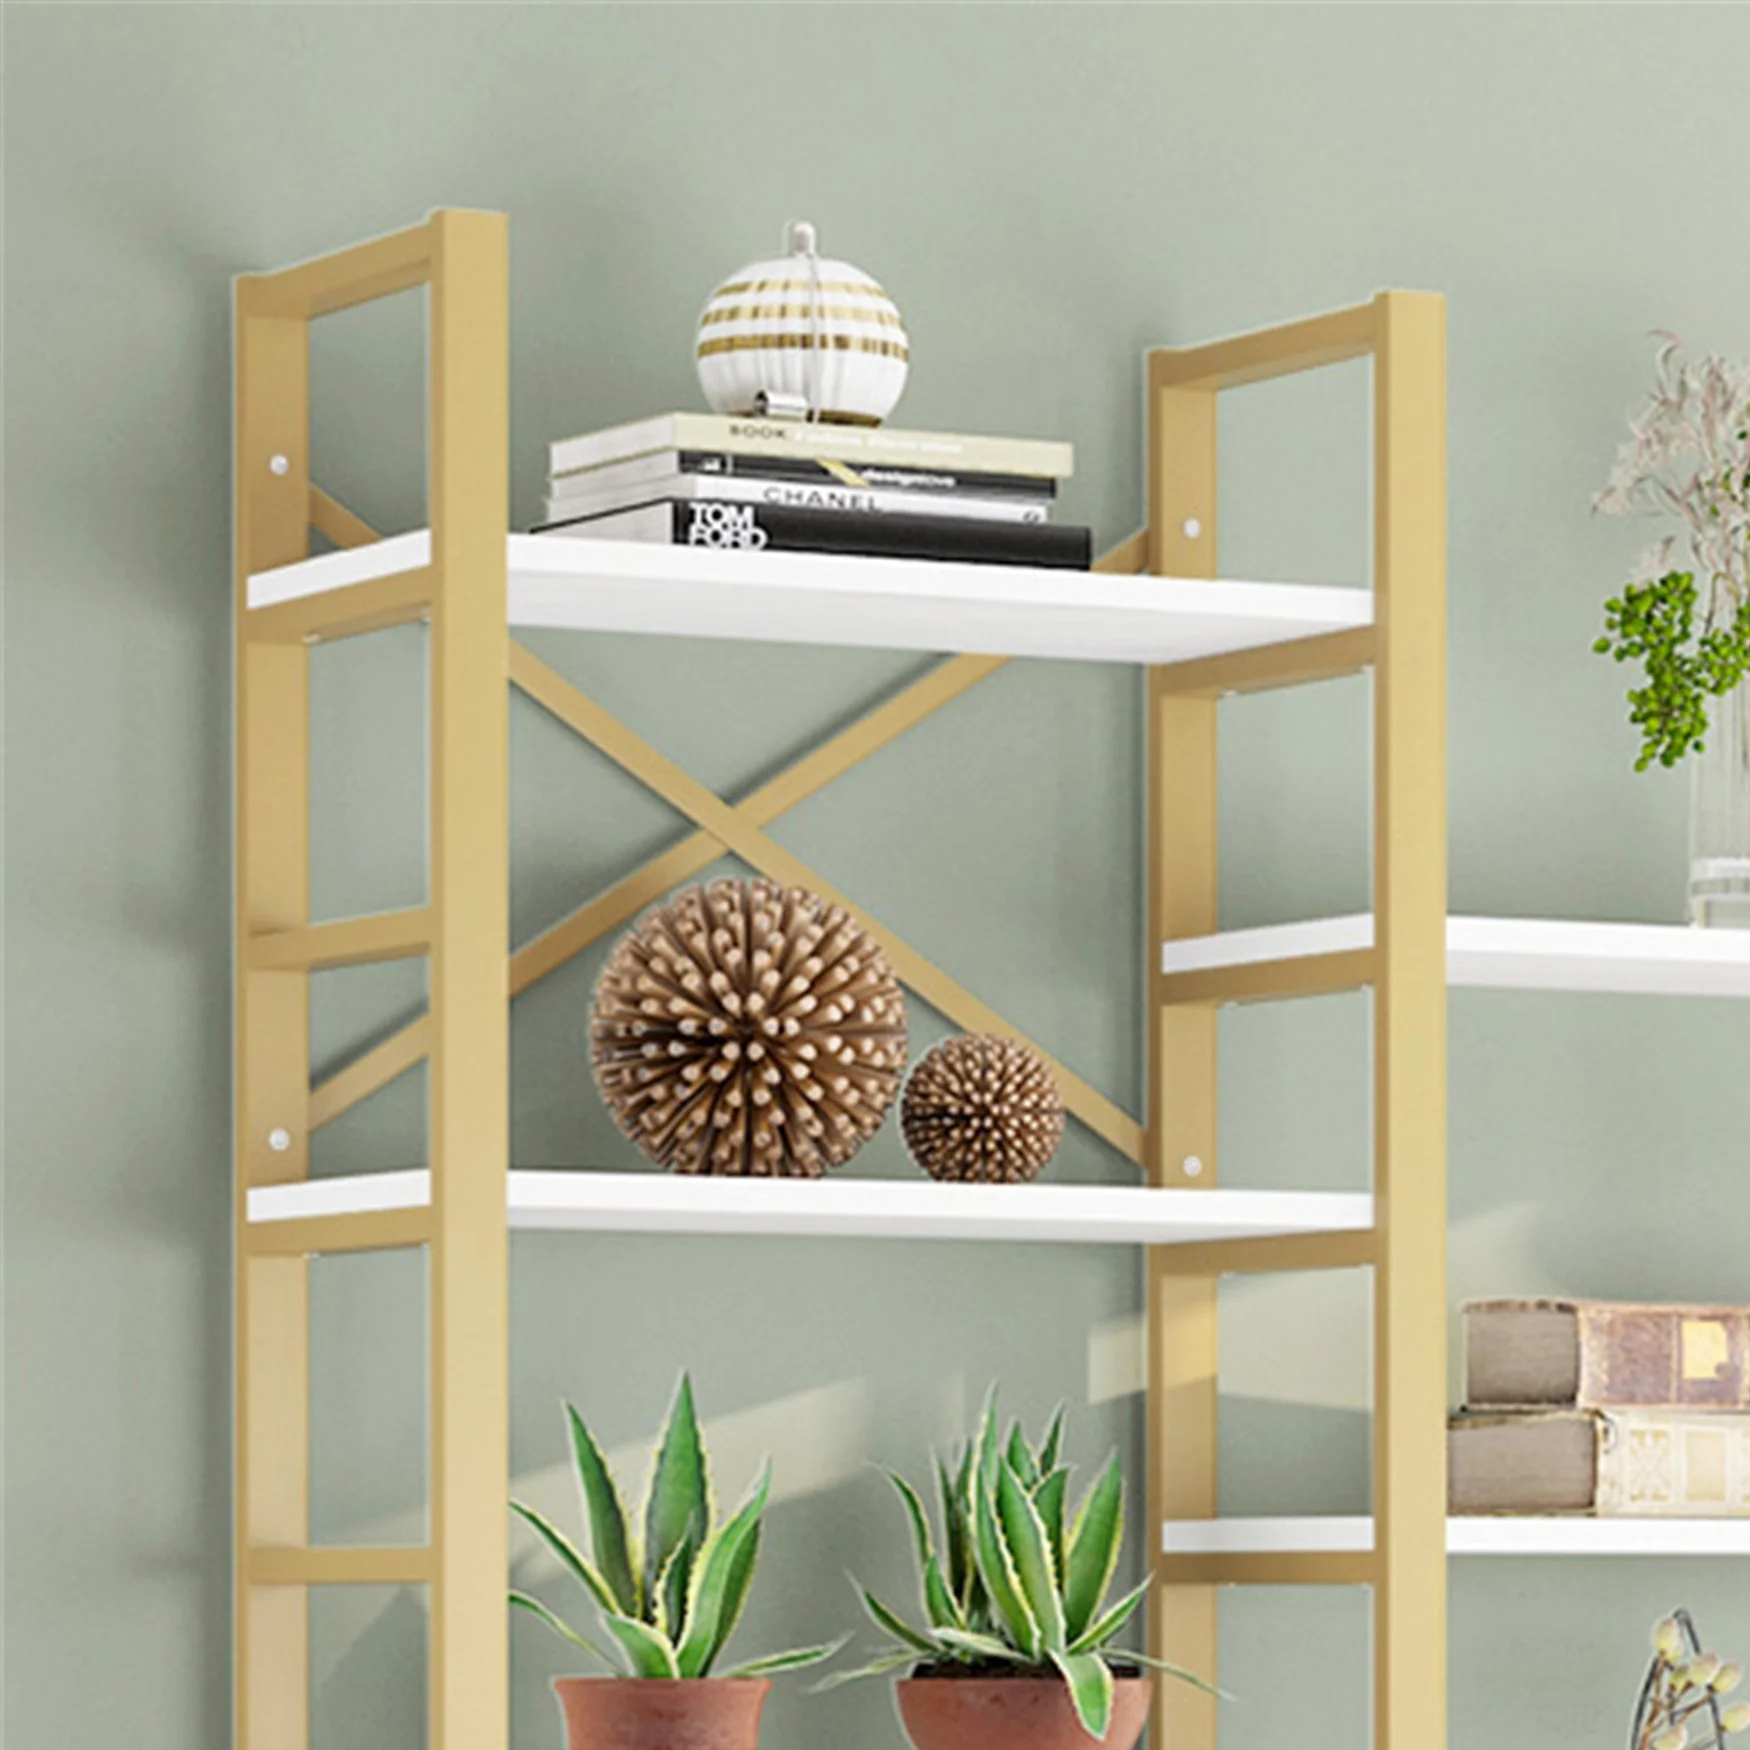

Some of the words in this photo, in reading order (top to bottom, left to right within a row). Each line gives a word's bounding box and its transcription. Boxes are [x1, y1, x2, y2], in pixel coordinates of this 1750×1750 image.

[729, 424, 786, 440] BOOK
[763, 486, 883, 512] CHANEL
[689, 502, 755, 526] TOM
[689, 523, 769, 551] FORD
